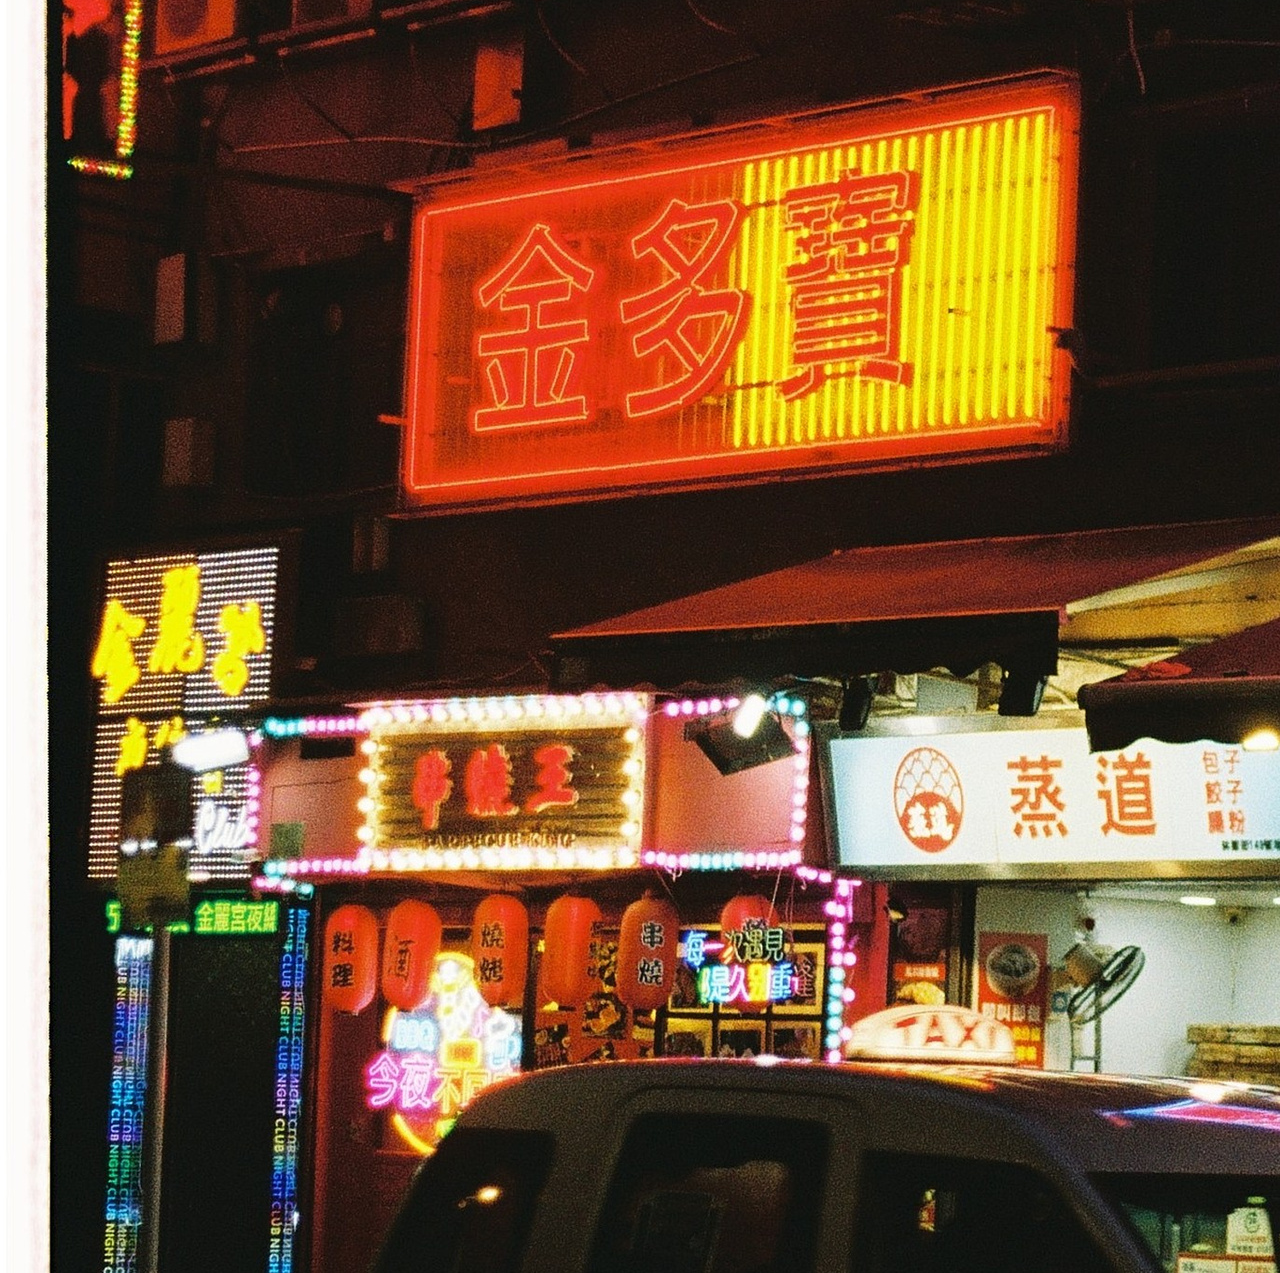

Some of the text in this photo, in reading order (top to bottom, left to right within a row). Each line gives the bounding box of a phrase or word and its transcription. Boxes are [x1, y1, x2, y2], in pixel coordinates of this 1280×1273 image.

[473, 167, 917, 432] 金多寶
[1202, 749, 1241, 774] 包子
[1006, 751, 1158, 840] 蒸道
[331, 930, 355, 988] 料理
[638, 920, 665, 987] 串燒
[894, 1013, 997, 1049] TAXI
[366, 1053, 519, 1114] 今夜不
